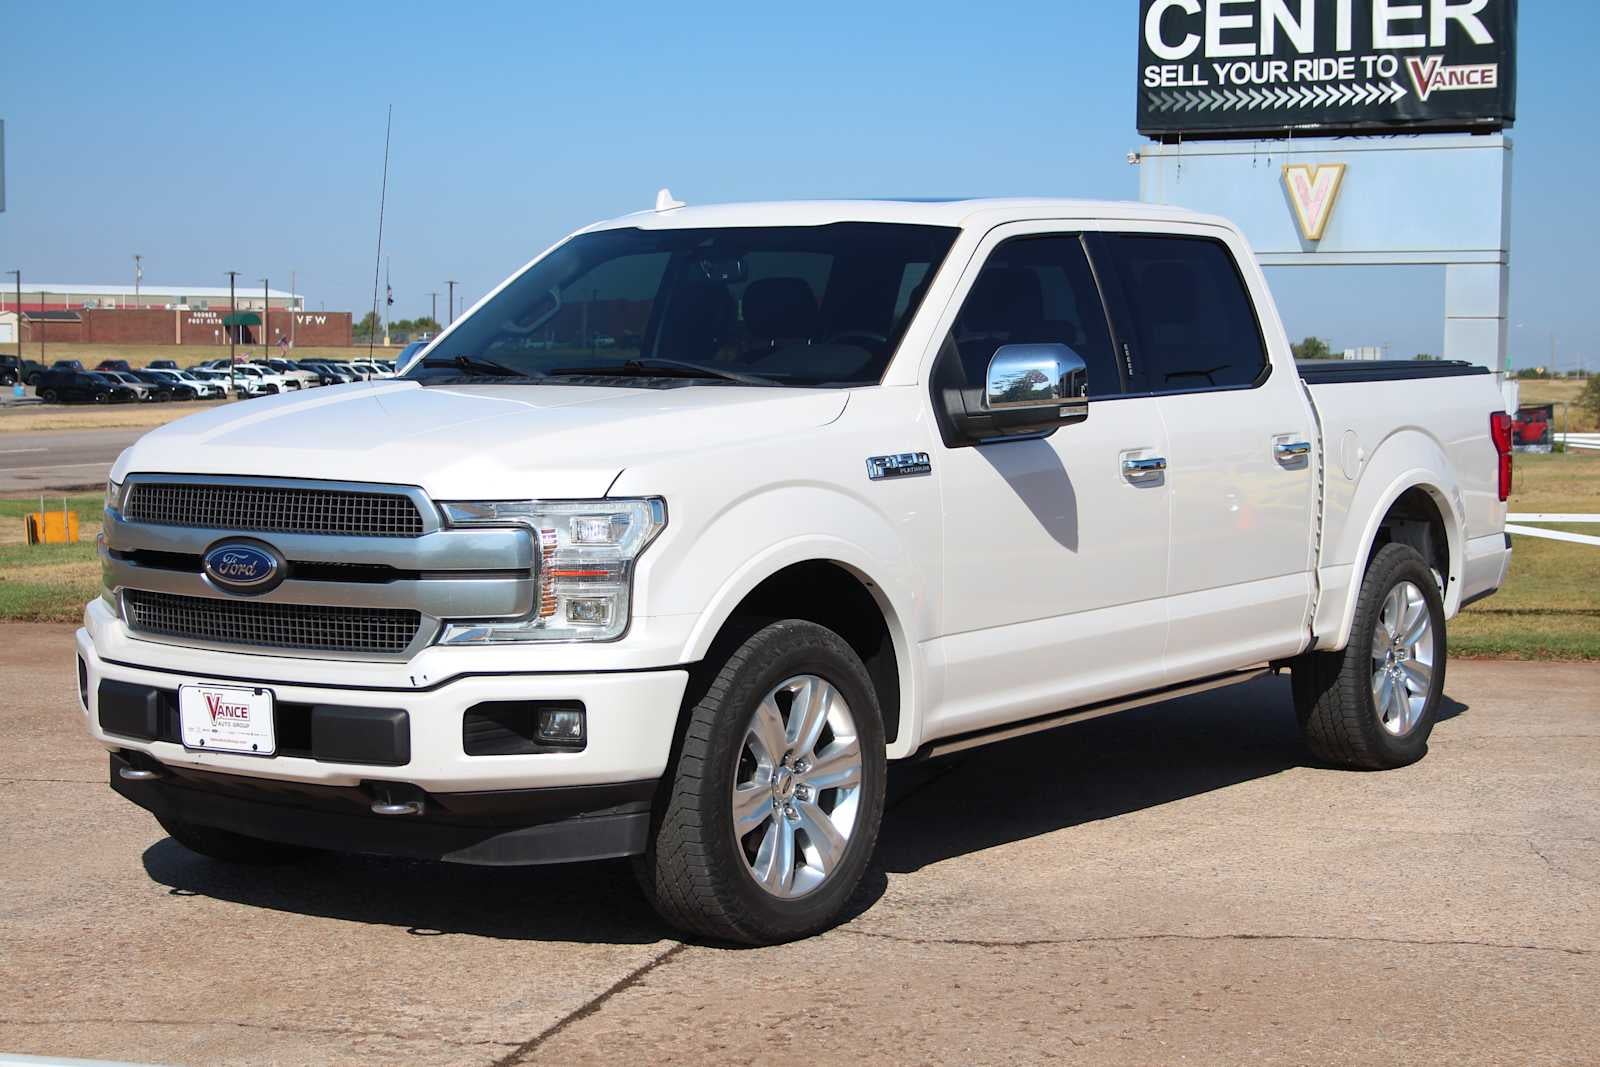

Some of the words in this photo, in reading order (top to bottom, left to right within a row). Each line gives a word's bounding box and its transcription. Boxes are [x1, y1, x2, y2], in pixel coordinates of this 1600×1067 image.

[1143, 63, 1209, 88] SELL
[1212, 60, 1288, 86] YOUR
[1293, 56, 1356, 82] RIDE
[1360, 54, 1399, 79] TO
[1407, 57, 1495, 99] VANCE
[296, 315, 327, 325] VFW
[219, 552, 259, 577] Ford
[204, 694, 249, 722] VANCE
